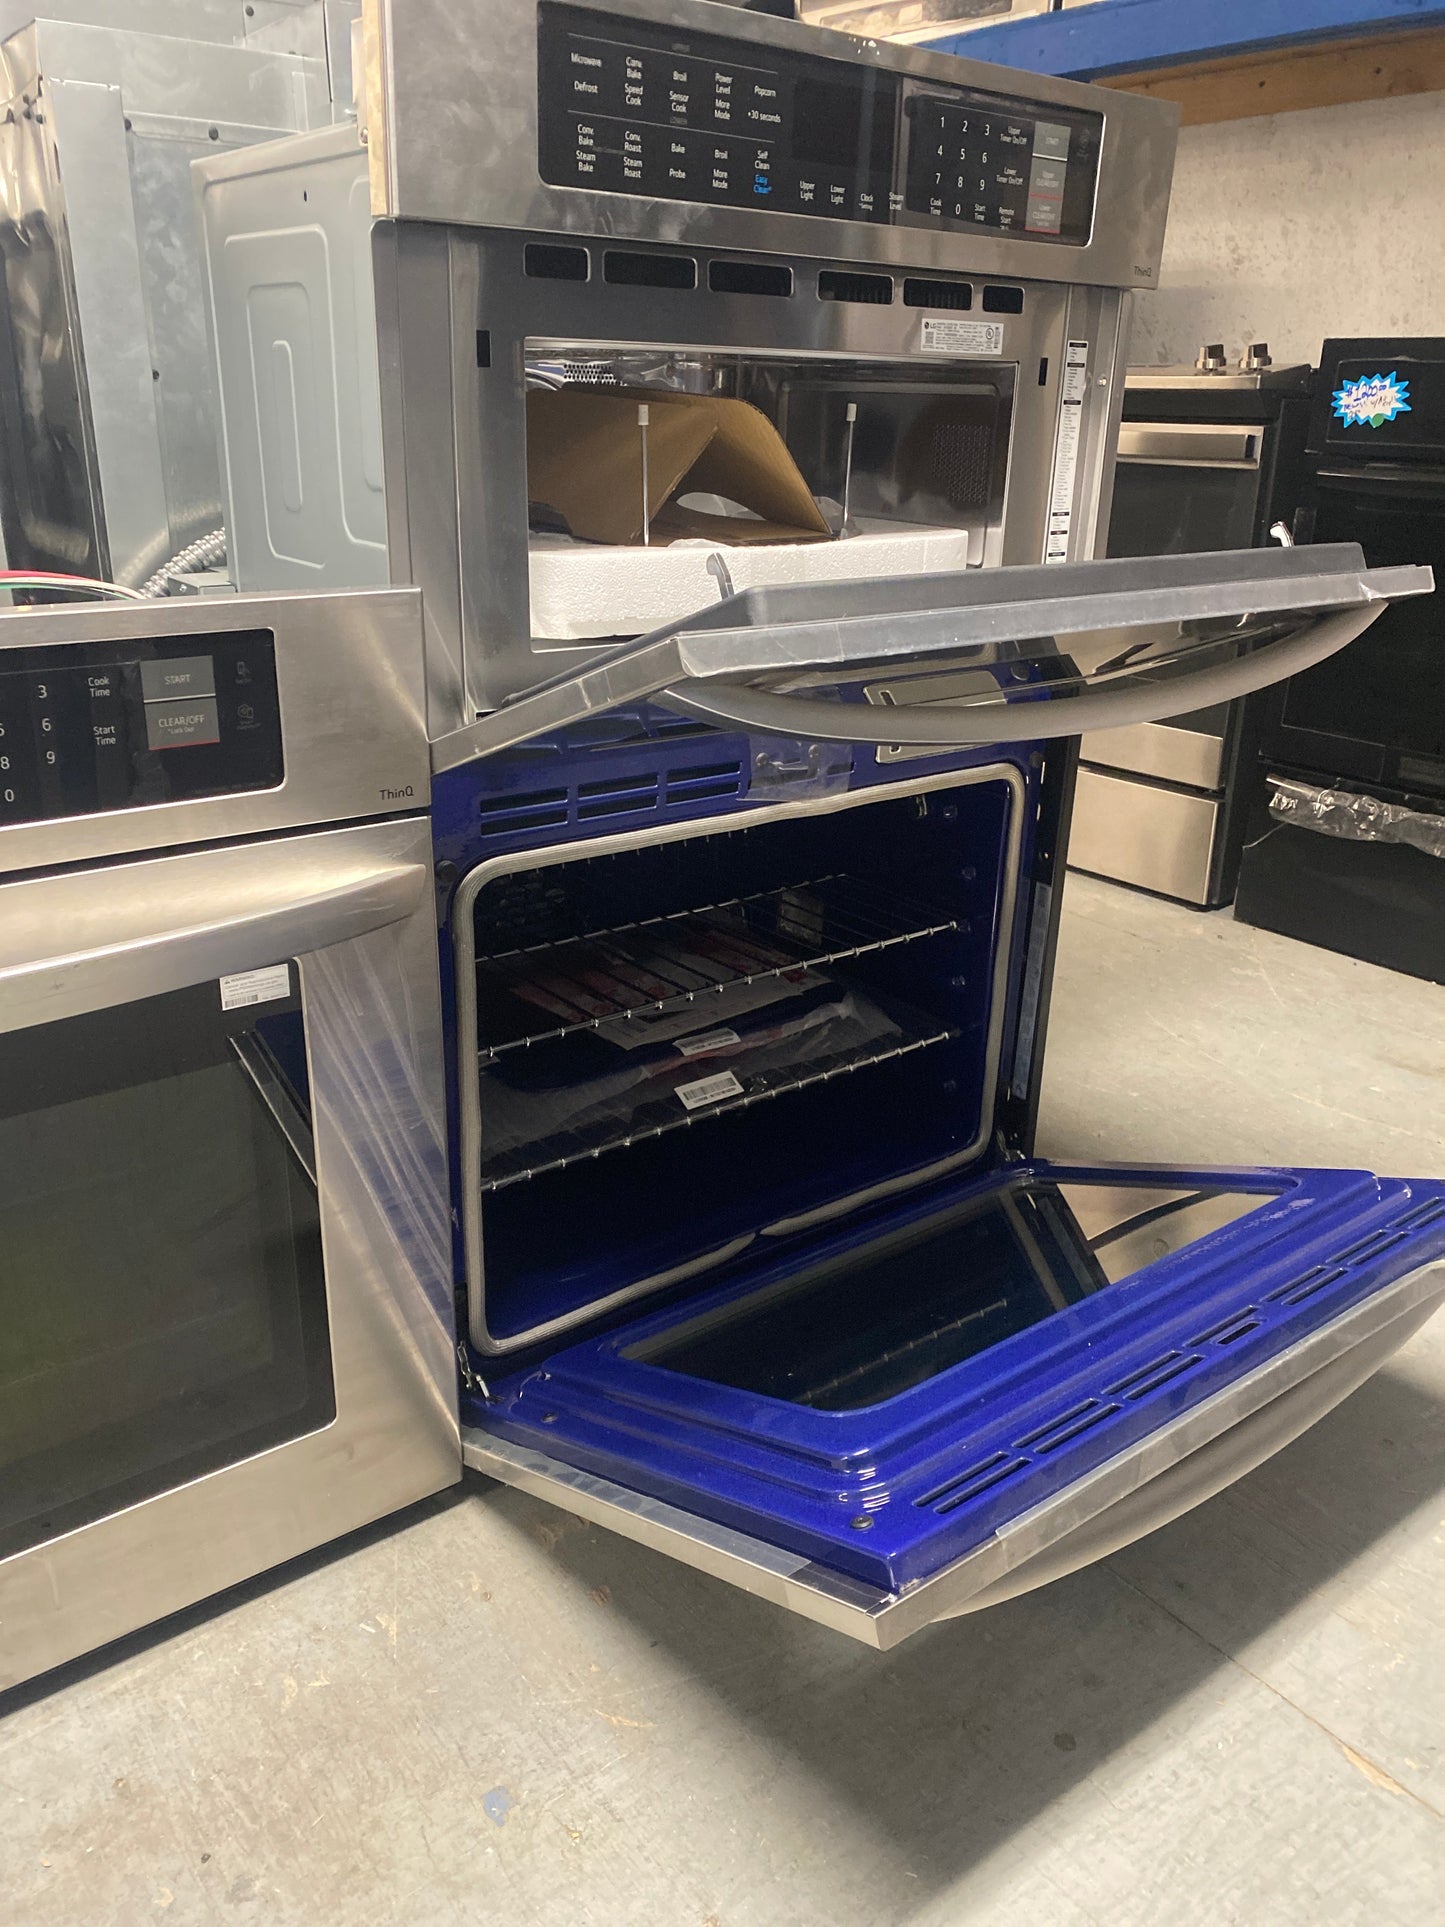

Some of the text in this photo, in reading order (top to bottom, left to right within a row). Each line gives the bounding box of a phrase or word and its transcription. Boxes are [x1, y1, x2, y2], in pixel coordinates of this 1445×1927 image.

[571, 52, 601, 67] Microwave
[673, 71, 687, 82] Broil
[715, 72, 732, 84] Power
[574, 81, 598, 94] Defrost
[625, 83, 643, 95] Speed
[716, 84, 730, 94] Level
[754, 85, 776, 97] Popcorn
[626, 94, 641, 106] Cook
[670, 91, 689, 102] Sensor
[672, 102, 686, 112] Cook
[716, 99, 730, 110] More
[714, 110, 730, 120] Mode
[760, 112, 781, 122] seconds
[940, 116, 945, 128] 1
[962, 120, 968, 132] 2
[984, 124, 990, 136] 3
[578, 136, 594, 146] Bake
[624, 142, 642, 152] Roast
[671, 143, 685, 154] Bake
[938, 144, 942, 156] 4
[576, 150, 596, 161] Steam
[714, 150, 728, 160] Broil
[757, 150, 768, 160] Self
[960, 148, 966, 160] 5
[982, 152, 988, 164] 6
[578, 162, 594, 172] Bake
[624, 156, 642, 168] Steam
[754, 160, 770, 170] Clean
[624, 168, 641, 178] Roast
[669, 168, 686, 178] Probe
[714, 168, 728, 178] More
[936, 172, 940, 184] 7
[712, 179, 728, 189] Mode
[755, 174, 768, 186] Easy
[800, 180, 815, 191] Upper
[958, 176, 963, 188] 8
[980, 180, 985, 191] 9
[830, 184, 846, 194] Lower
[800, 190, 814, 202] Light
[830, 194, 844, 205] Light
[860, 193, 874, 202] Clock
[889, 192, 904, 202] Steam
[890, 202, 902, 211] Level
[930, 198, 942, 206] Cook
[930, 206, 941, 216] Time
[956, 204, 961, 215] 0
[974, 204, 986, 212] Start
[974, 212, 984, 222] Time
[88, 676, 110, 687] Cook
[164, 674, 190, 686] START
[38, 685, 47, 698] 3
[90, 688, 110, 698] Time
[42, 718, 52, 732] 6
[159, 714, 205, 728] CLEAR/OFF
[93, 726, 116, 736] Start
[96, 736, 116, 746] Time
[0, 756, 10, 770] 8
[46, 751, 55, 764] 9
[4, 789, 14, 802] 0
[379, 786, 414, 800] ThinQ
